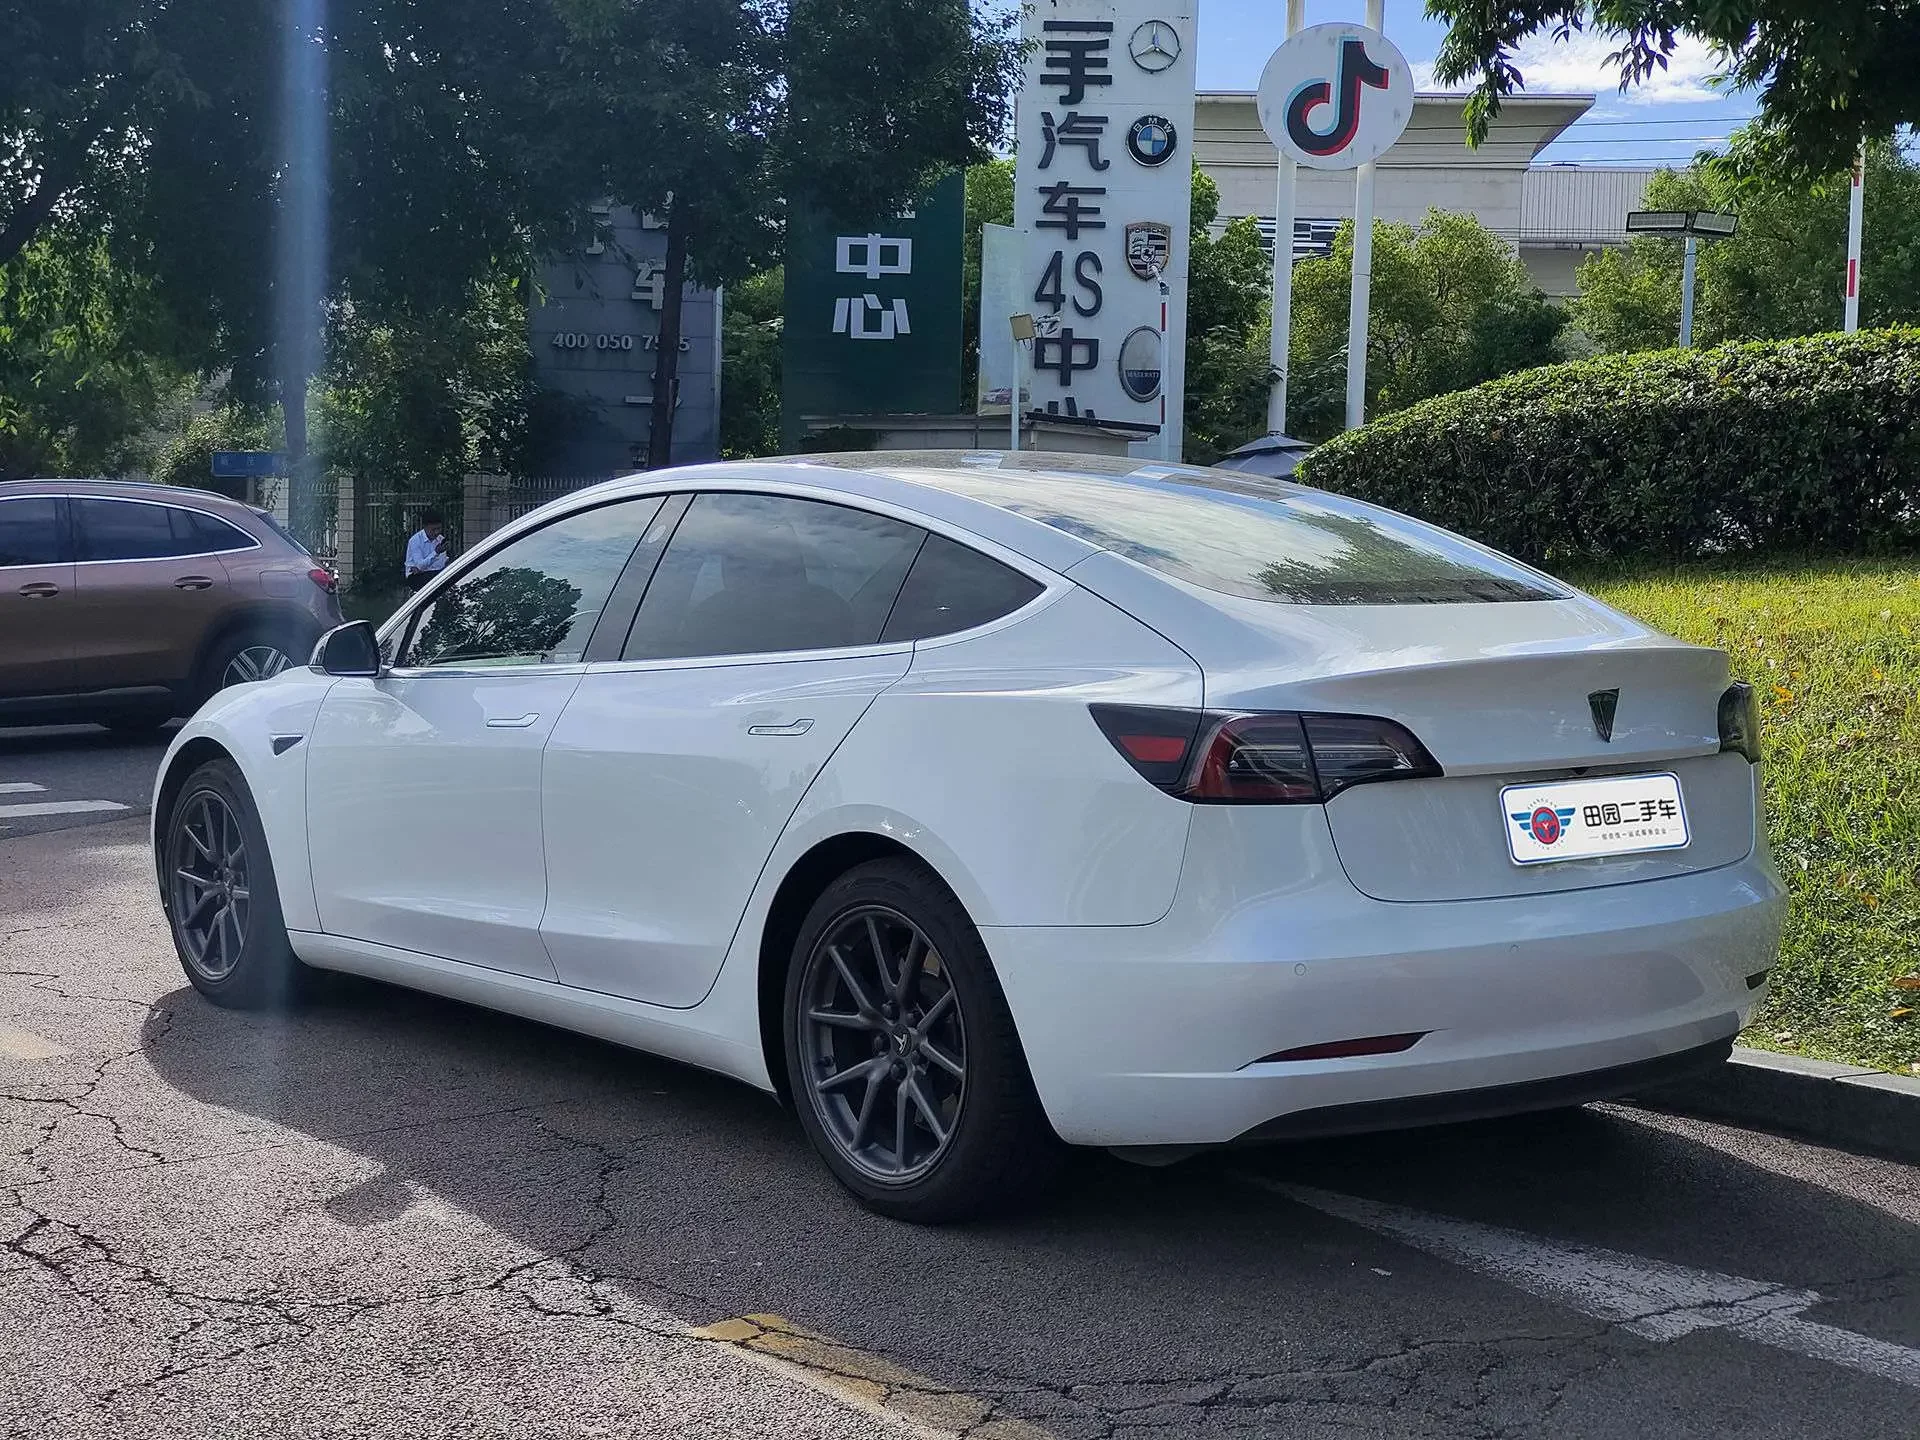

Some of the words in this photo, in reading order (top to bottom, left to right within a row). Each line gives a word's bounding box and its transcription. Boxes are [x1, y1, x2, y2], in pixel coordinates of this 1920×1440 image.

[1133, 117, 1173, 133] BMW
[552, 333, 589, 348] 400
[596, 334, 632, 350] 050
[1583, 799, 1677, 828] 田园二手车
